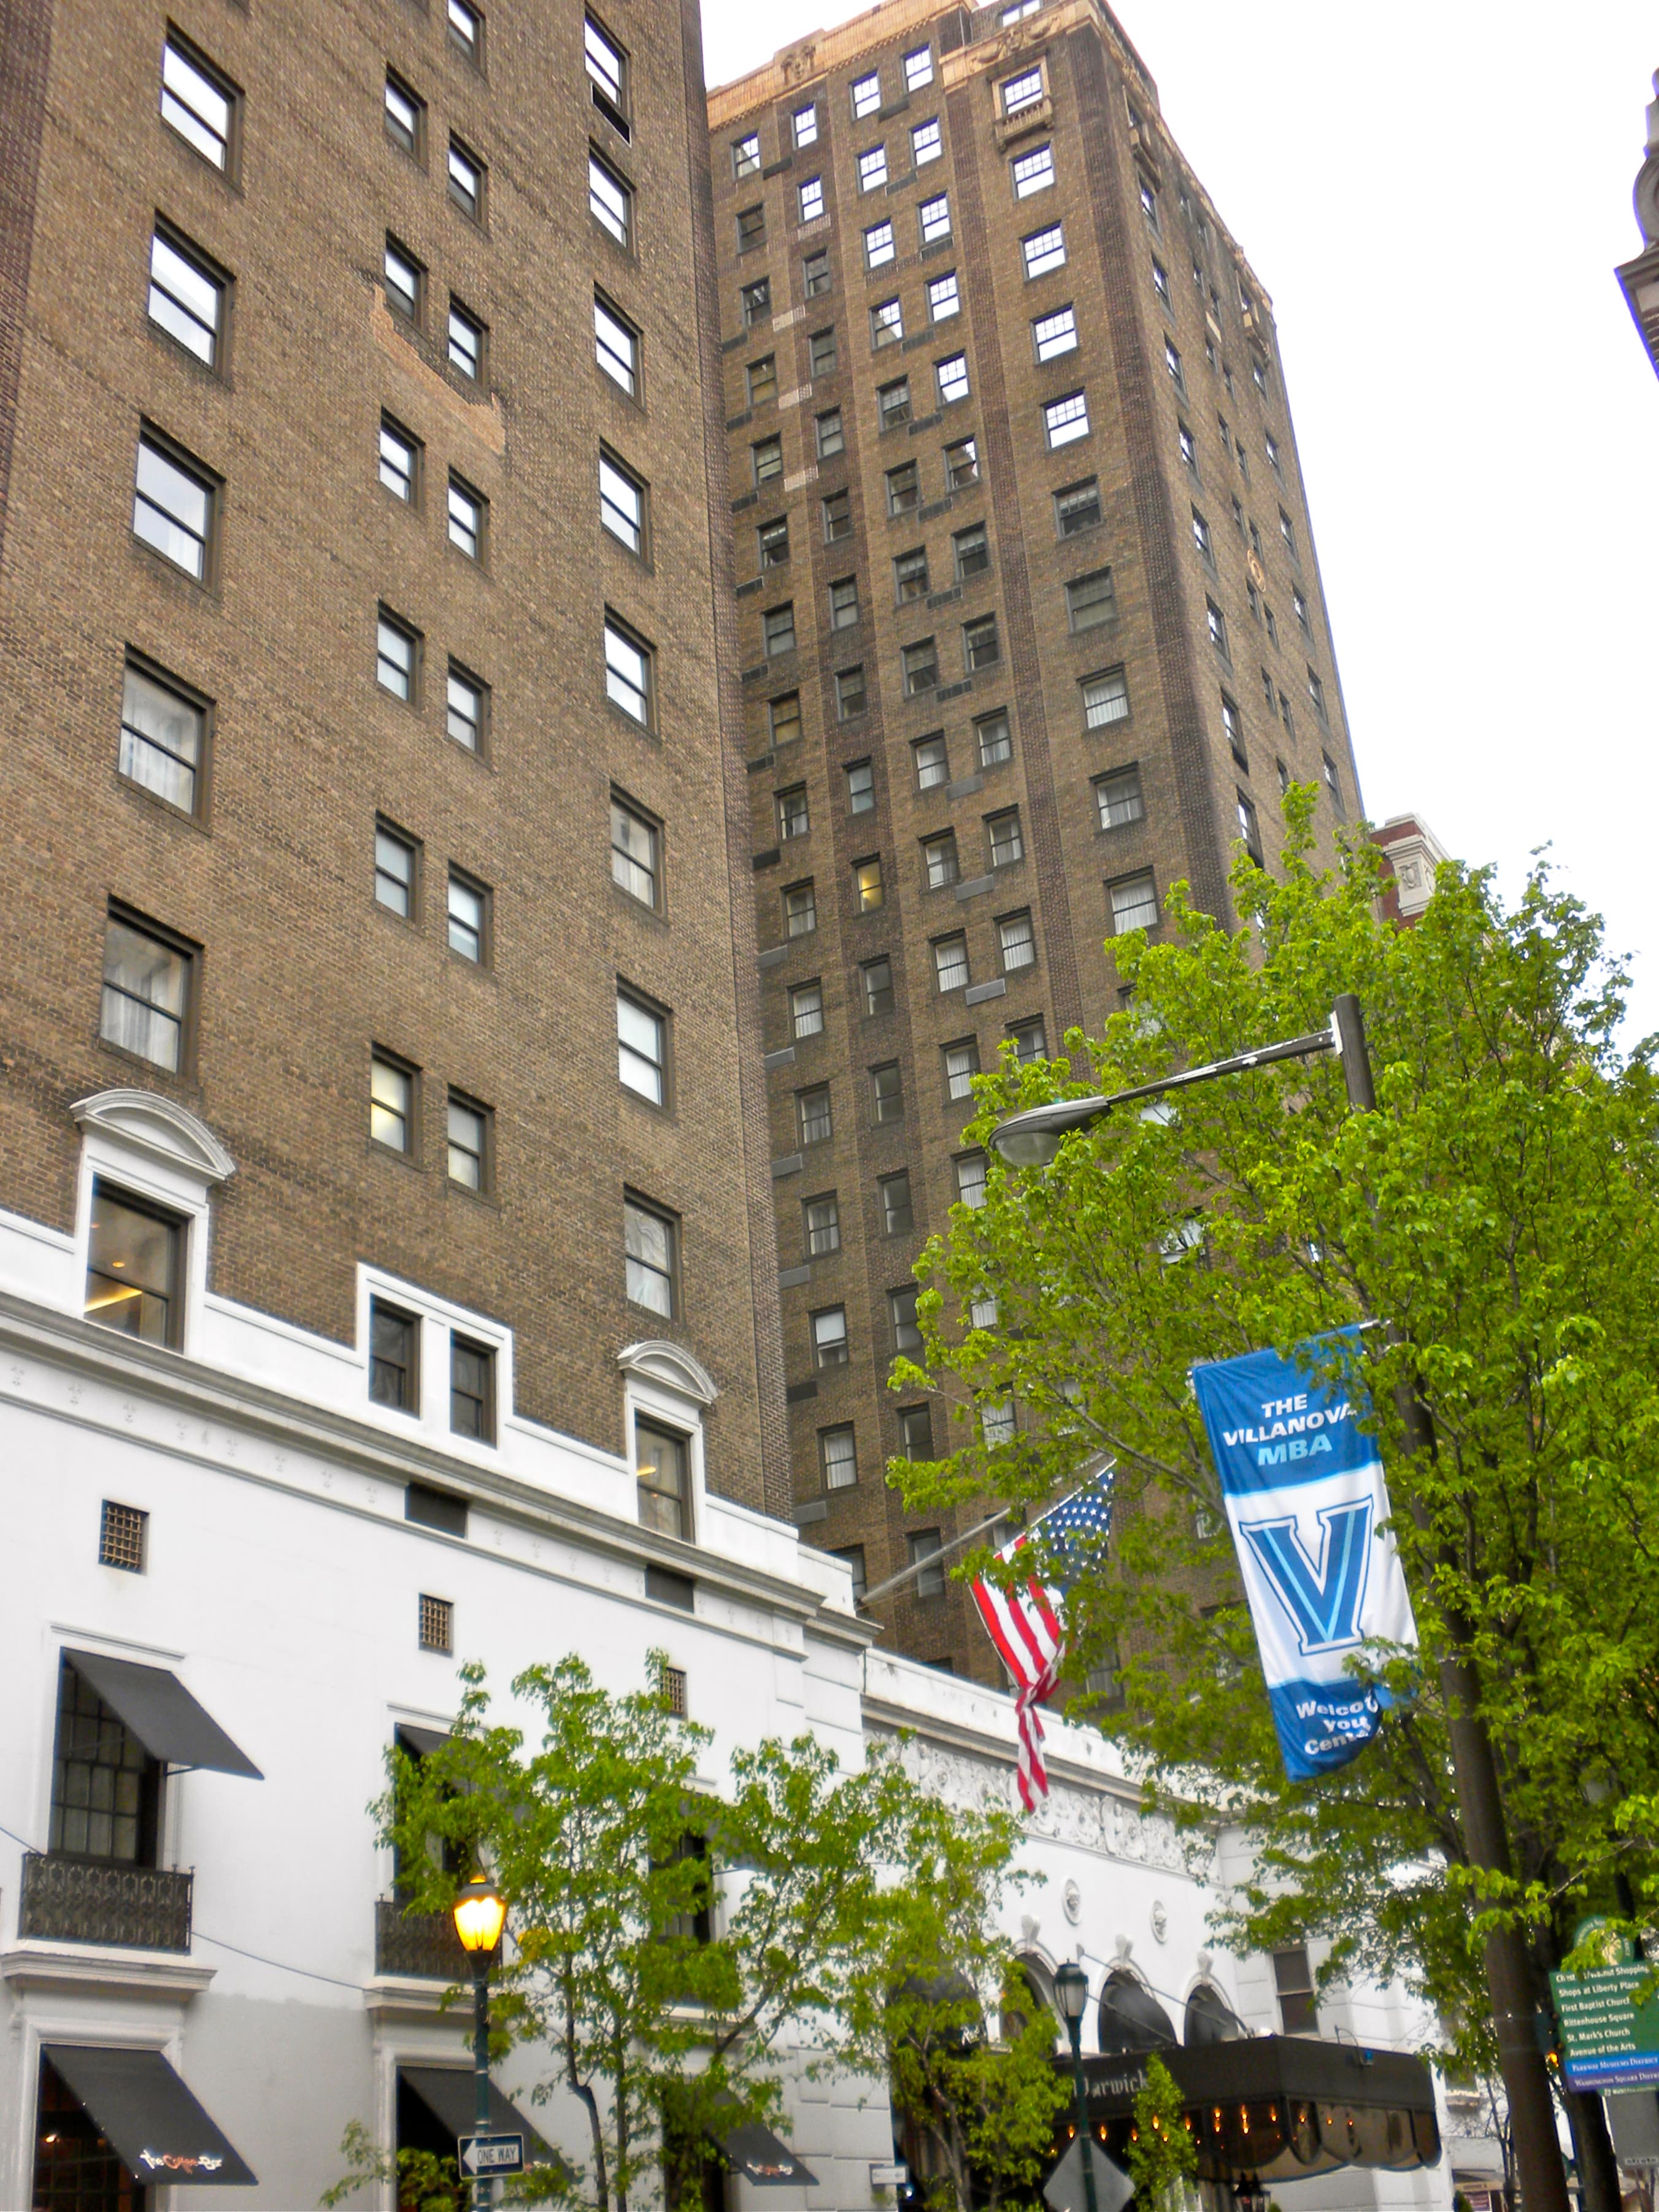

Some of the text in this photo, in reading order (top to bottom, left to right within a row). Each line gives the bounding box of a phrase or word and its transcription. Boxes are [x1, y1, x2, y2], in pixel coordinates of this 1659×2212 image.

[1261, 1394, 1307, 1418] THE
[1223, 1403, 1357, 1446] VILLANOVA
[1258, 1434, 1333, 1466] MBA
[1239, 1495, 1374, 1656] V
[1559, 1988, 1581, 1998] Shops
[1592, 1983, 1618, 1993] Liberty
[1620, 1981, 1640, 1991] Place
[1561, 2003, 1578, 2013] First
[1579, 2000, 1605, 2011] Baptist
[1563, 2012, 1634, 2027] Rittenhouse Square
[1567, 2027, 1630, 2043] St. Mark's Church
[1570, 2042, 1636, 2057] Avenue of the Arts
[477, 2147, 516, 2164] ONE WAY
